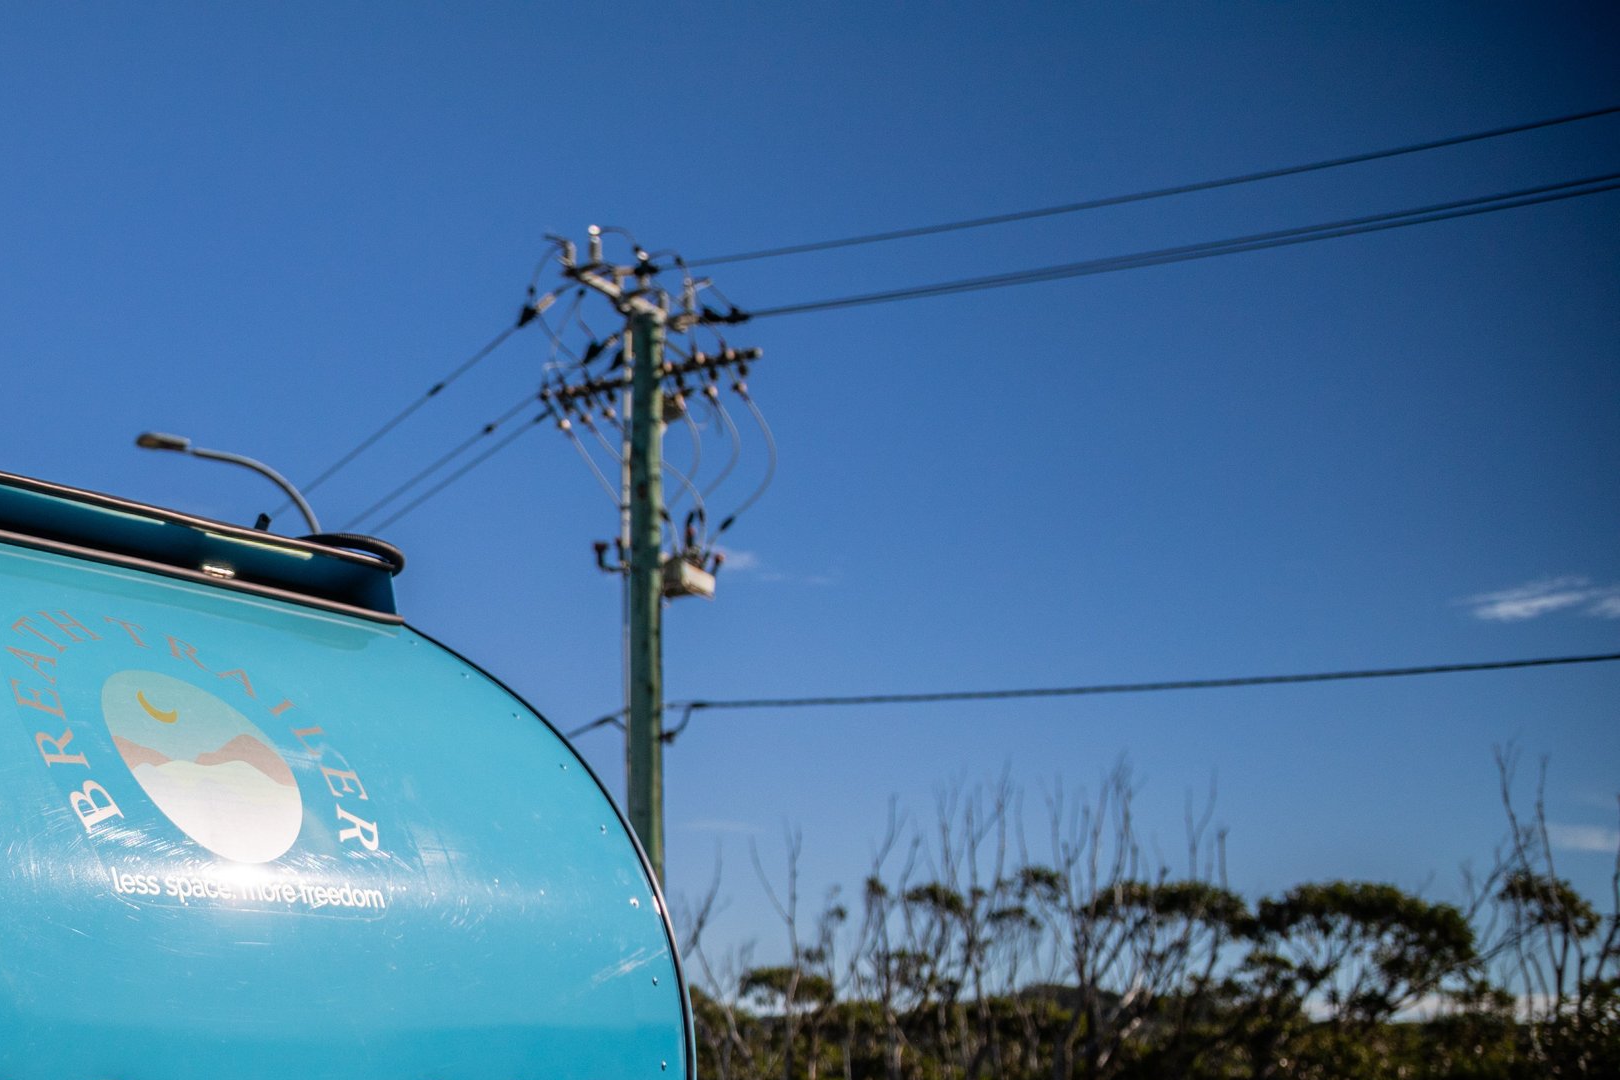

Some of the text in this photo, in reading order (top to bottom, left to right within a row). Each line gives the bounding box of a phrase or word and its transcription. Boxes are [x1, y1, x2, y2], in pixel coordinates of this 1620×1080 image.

[5, 610, 379, 852] BREATH TRAILER
[111, 866, 161, 896] less
[241, 878, 297, 904] more
[299, 879, 386, 909] freedom
